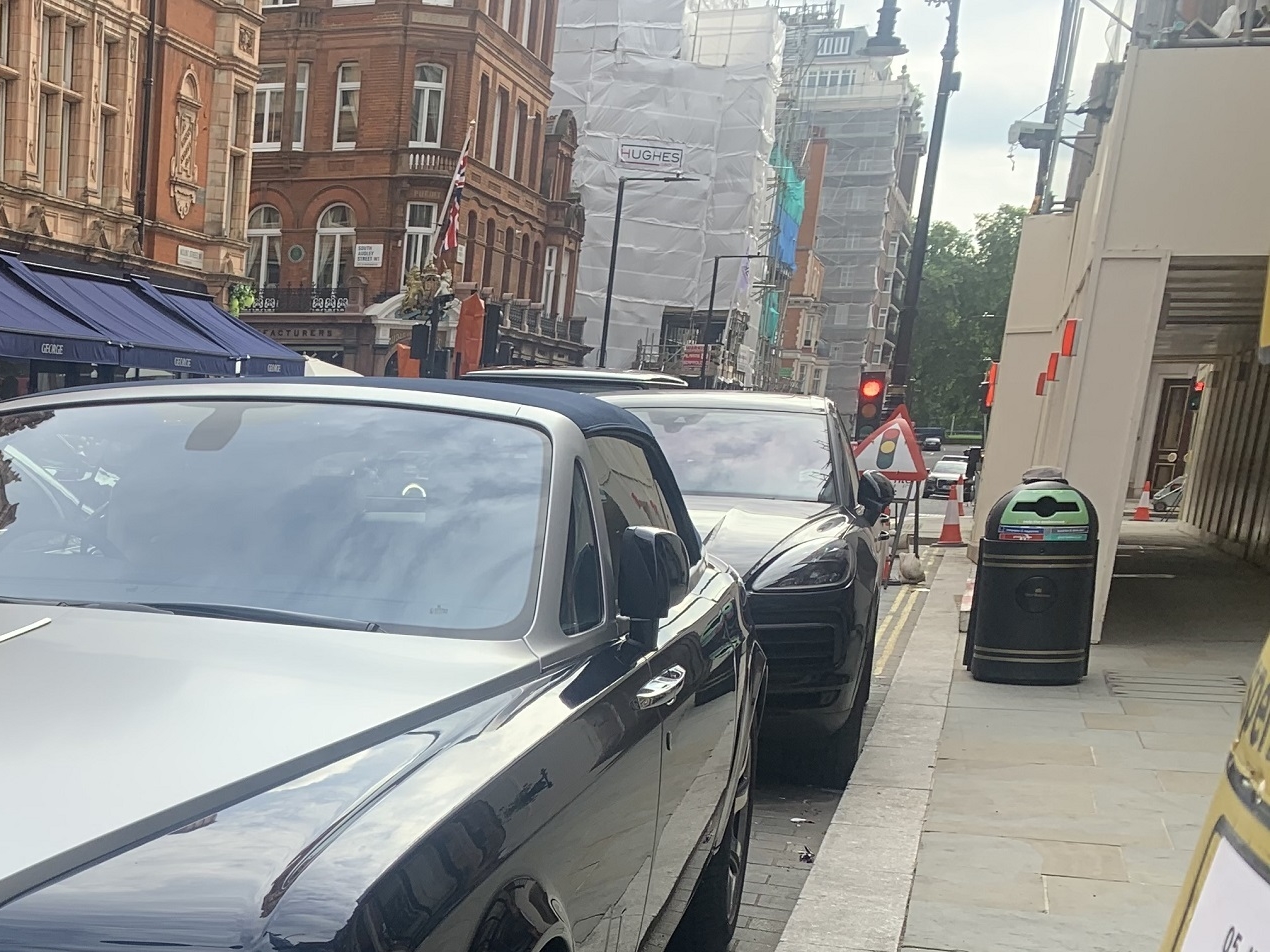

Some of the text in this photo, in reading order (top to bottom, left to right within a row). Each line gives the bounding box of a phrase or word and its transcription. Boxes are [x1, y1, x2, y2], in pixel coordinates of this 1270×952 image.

[621, 149, 680, 163] HUGHES
[41, 343, 64, 355] GEORGE
[174, 356, 192, 368] GEORGE
